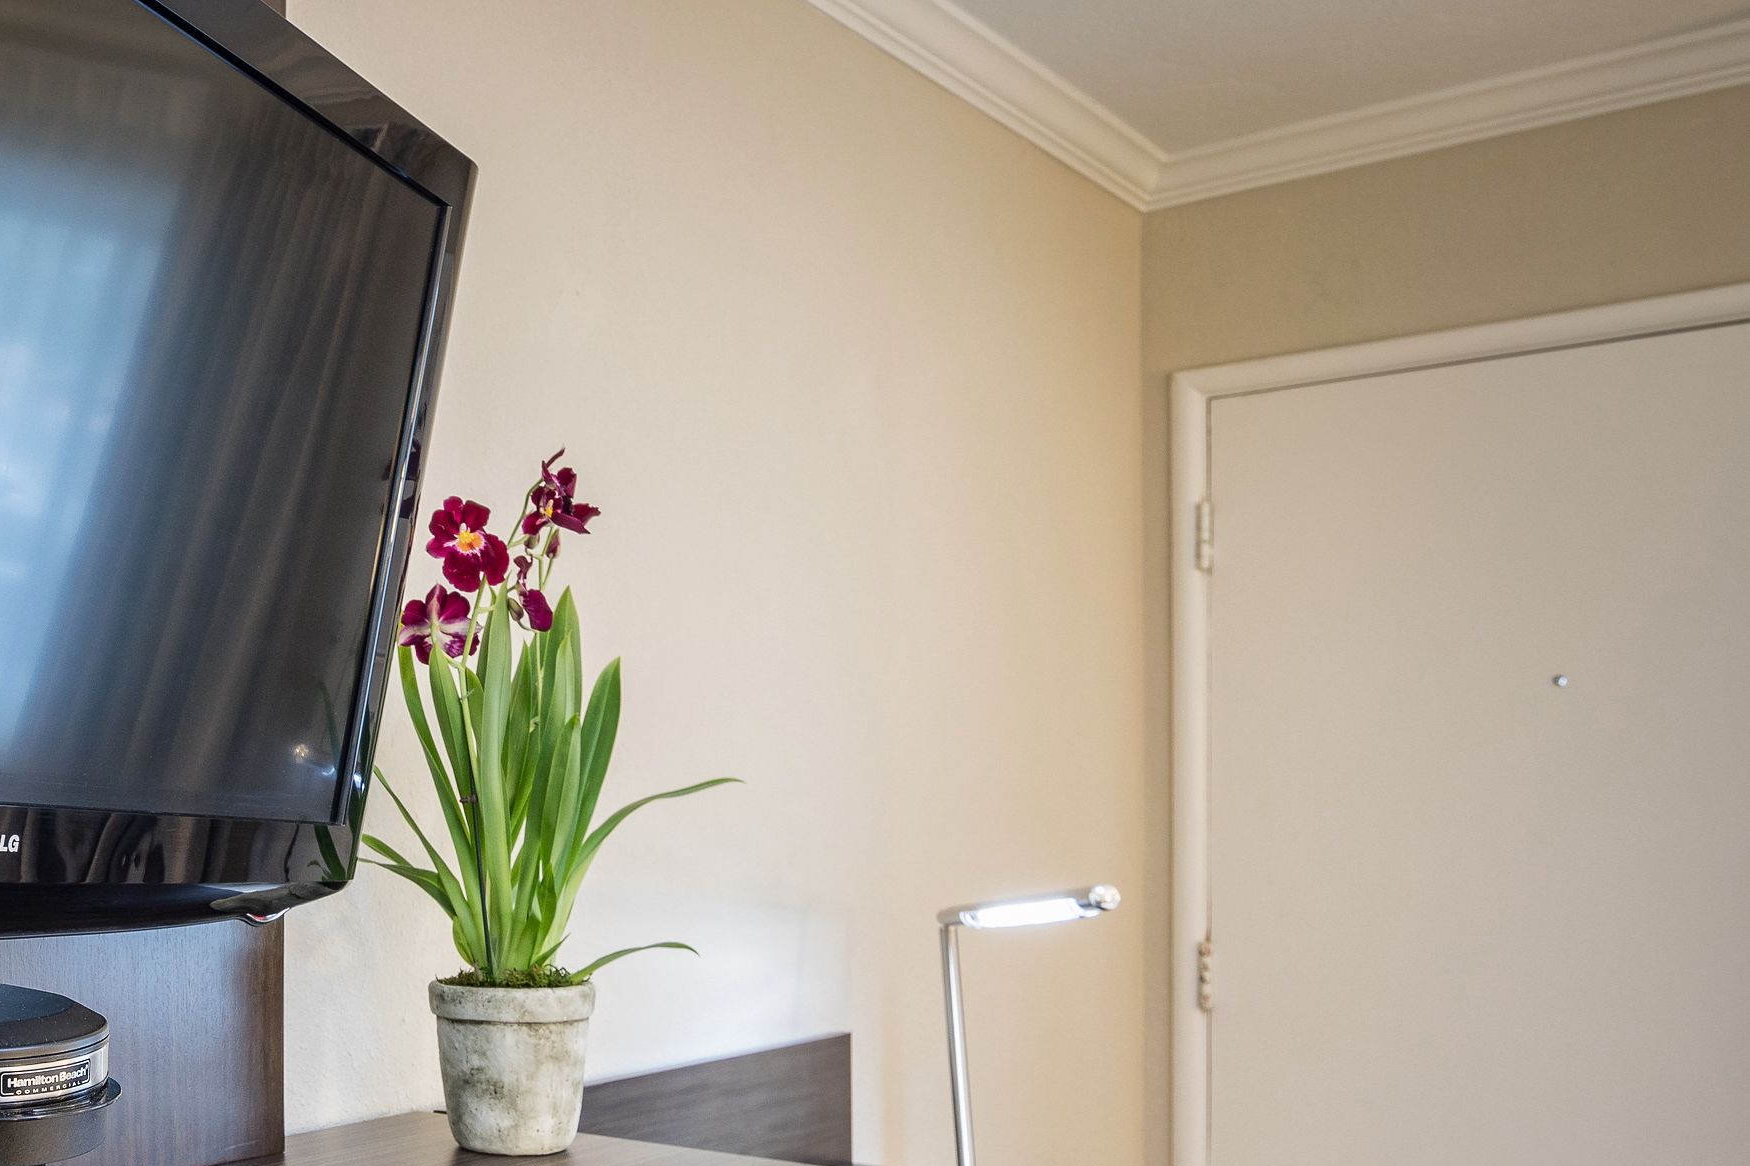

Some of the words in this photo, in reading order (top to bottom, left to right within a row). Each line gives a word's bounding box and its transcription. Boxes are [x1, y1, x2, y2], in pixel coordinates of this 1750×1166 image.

[7, 1073, 59, 1088] Hamilton
[59, 1067, 87, 1081] Beach
[15, 1081, 81, 1095] COMMERCIAL
